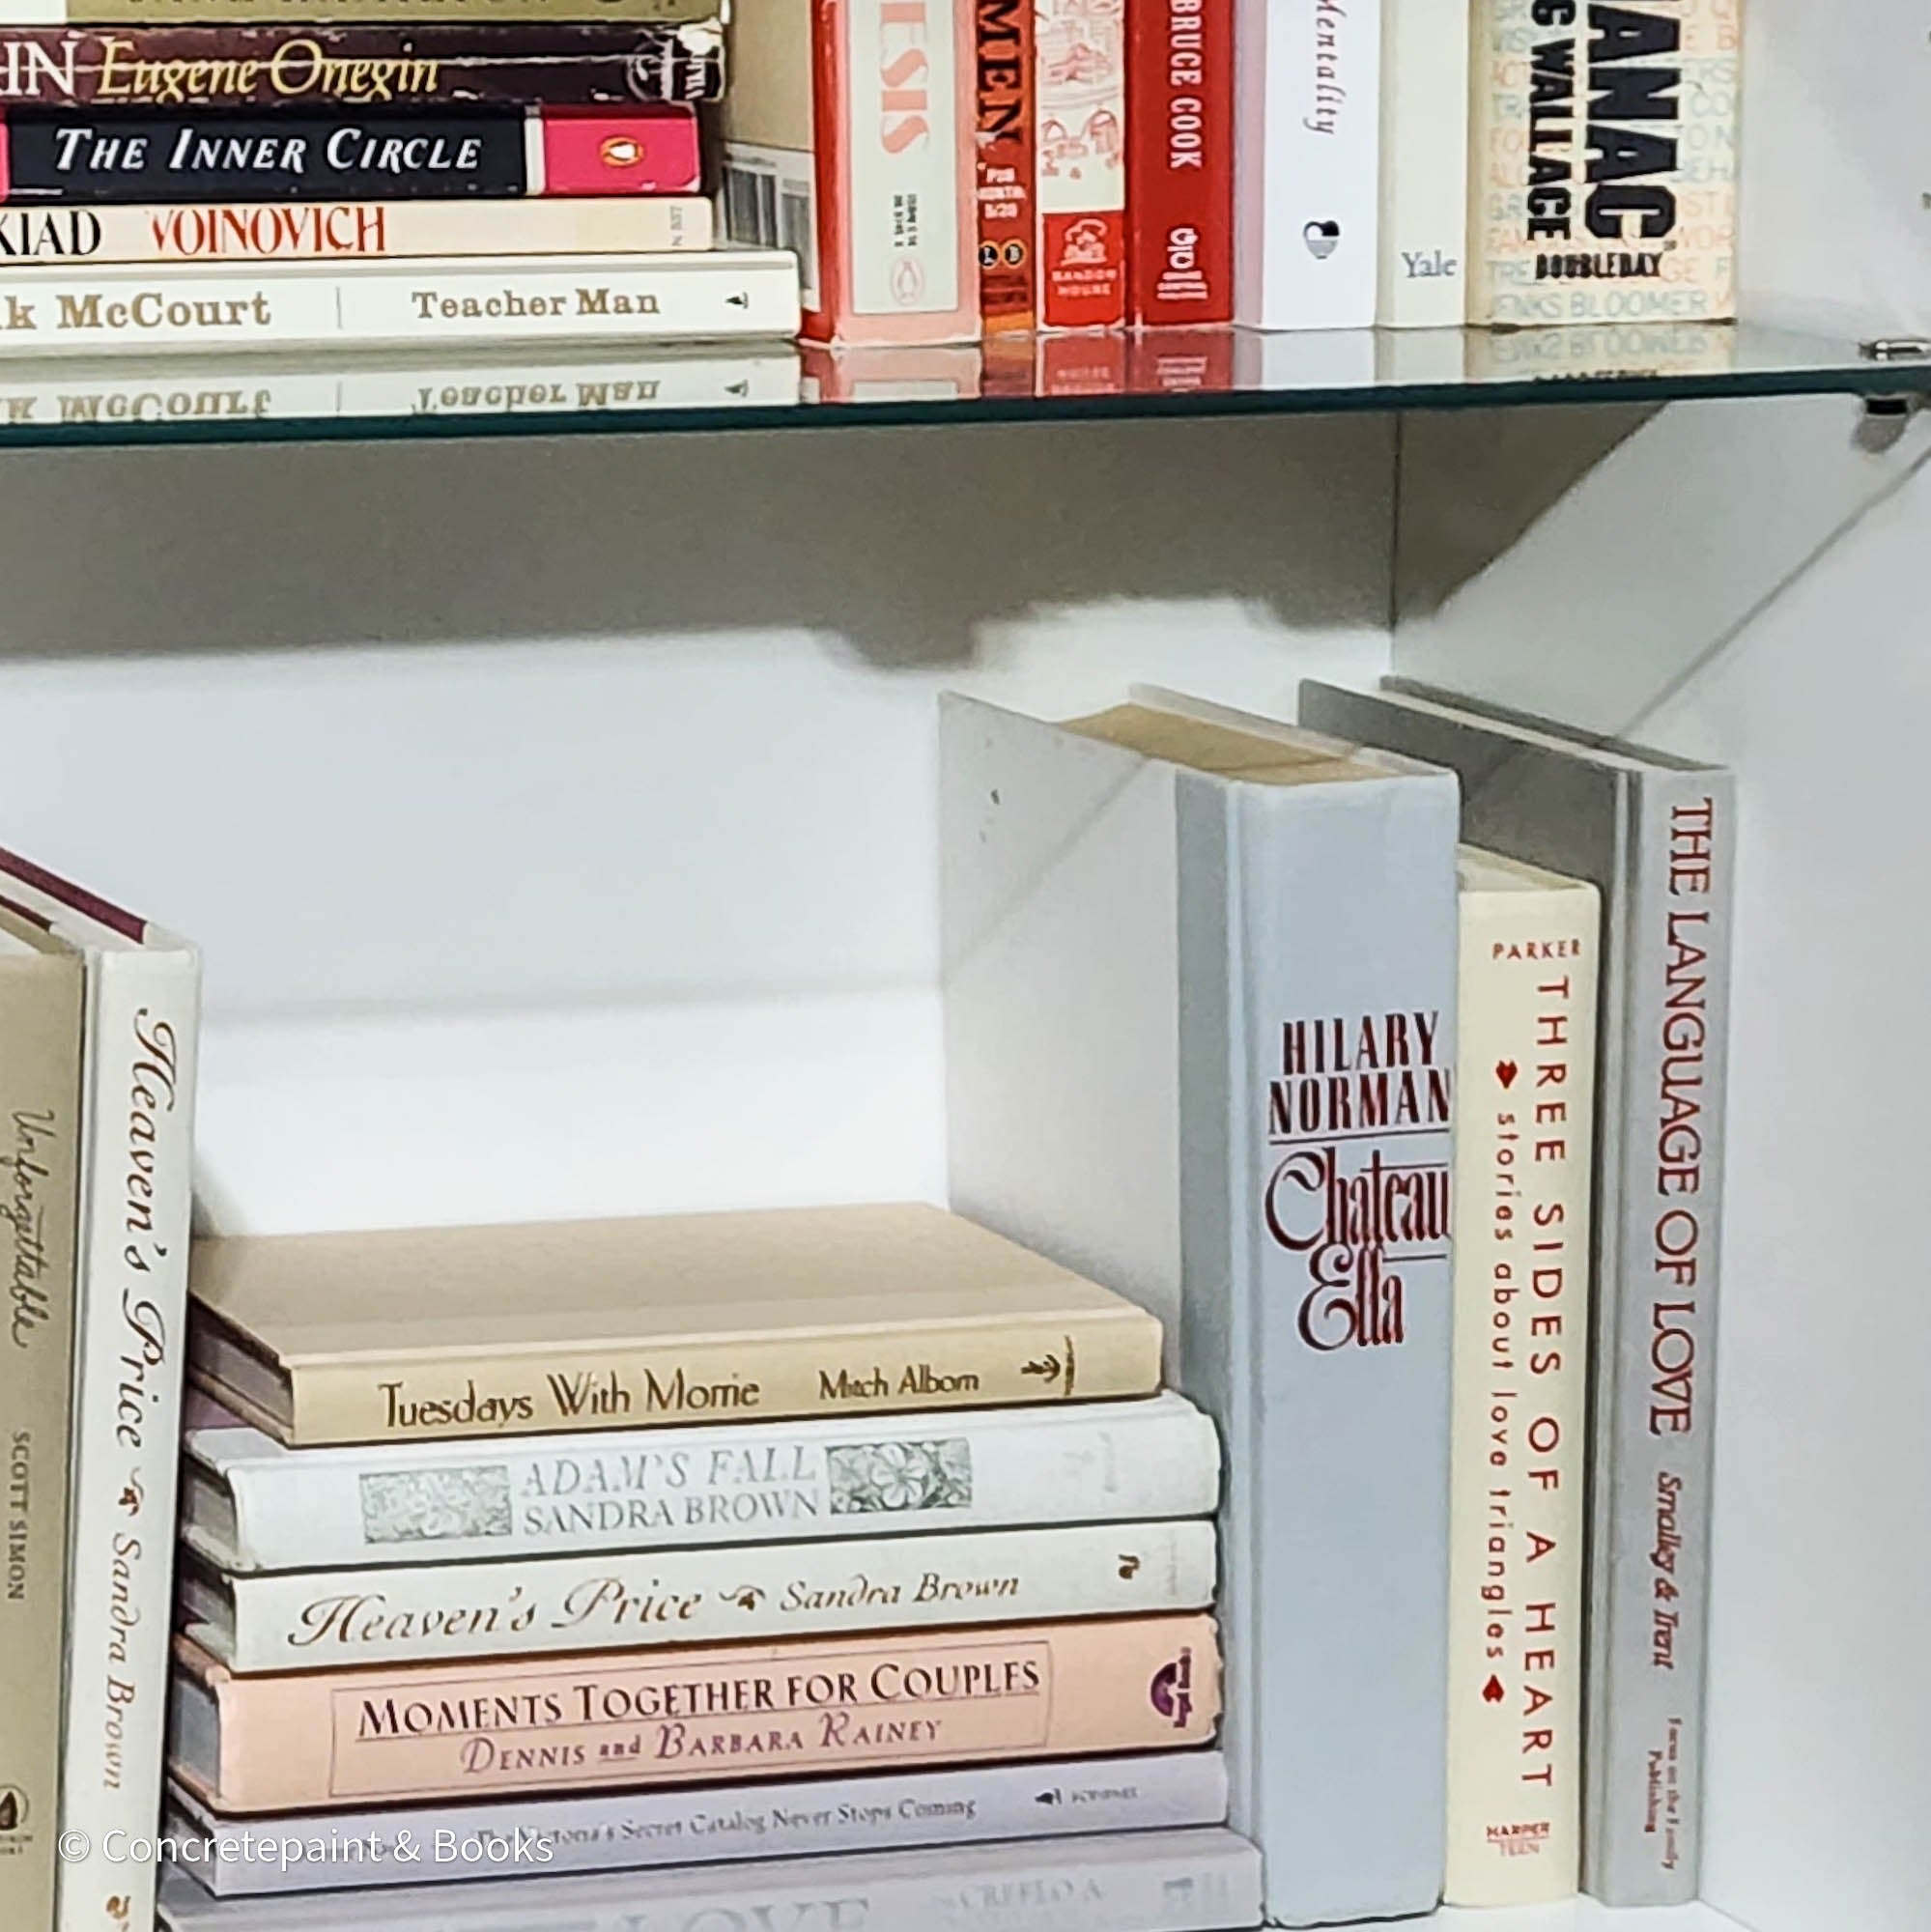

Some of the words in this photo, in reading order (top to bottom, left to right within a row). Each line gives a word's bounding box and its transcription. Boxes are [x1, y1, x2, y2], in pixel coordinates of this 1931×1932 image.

[0, 41, 75, 96] IN
[97, 36, 258, 103] Eugene
[271, 39, 439, 102] Onegin
[1170, 0, 1203, 86] BRUCE
[55, 128, 148, 171] THE
[168, 128, 307, 174] INNER
[327, 127, 482, 174] CIRCLE
[1170, 97, 1203, 169] COOK
[1527, 38, 1576, 242] WALLACE
[145, 206, 385, 256] VOINOVICH
[1401, 249, 1458, 278] Yale
[1536, 251, 1665, 280] DOUBLEDAY
[0, 296, 37, 329] k
[55, 291, 271, 329] McCourt
[412, 289, 568, 319] Teacher
[576, 288, 661, 316] Man
[1667, 796, 1714, 896] THE
[1492, 939, 1581, 960] PARKER
[1282, 1010, 1439, 1075] HILARY
[1533, 975, 1570, 1162] THREE
[1658, 909, 1711, 1197] LANGUAGE
[1267, 1067, 1452, 1135] NORMAN
[125, 1007, 178, 1273] Heaven's
[1493, 1112, 1520, 1240] stories
[1264, 1146, 1452, 1252] Chateau
[1654, 1208, 1701, 1288] OF
[1296, 1240, 1405, 1351] Ella
[1491, 1263, 1519, 1370] about
[1529, 1203, 1565, 1376] SIDES
[117, 1287, 168, 1450] Price
[378, 1379, 533, 1429] Tuesdays
[546, 1370, 631, 1417] With
[643, 1367, 760, 1412] Morrie
[818, 1366, 890, 1400] Mitch
[897, 1363, 980, 1396] Albom
[1648, 1299, 1697, 1436] LOVE
[1489, 1391, 1518, 1467] love
[1527, 1417, 1560, 1492] OF
[11, 1431, 32, 1514] SCOTT
[522, 1451, 690, 1498] ADAM'S
[706, 1444, 817, 1487] FALL
[523, 1498, 674, 1536] SANDRA
[684, 1490, 819, 1527] BROWN
[1525, 1530, 1557, 1563] A
[1648, 1470, 1683, 1574] Smalley
[7, 1520, 29, 1601] SIMON
[107, 1530, 142, 1662] Sandra
[1480, 1489, 1514, 1661] triangles
[1654, 1577, 1680, 1602] &
[287, 1585, 537, 1646] Heaven's
[550, 1576, 702, 1629] Price
[780, 1574, 901, 1612] Sandra
[913, 1572, 1021, 1604] Brown
[1652, 1605, 1679, 1671] Trent
[103, 1675, 135, 1790] Brown
[358, 1691, 562, 1738] MOMENTS
[573, 1678, 773, 1724] TOGETHER
[786, 1672, 859, 1707] FOR
[870, 1660, 1040, 1700] COUPLES
[1520, 1602, 1557, 1787] HEART
[459, 1737, 585, 1774] DENNIS
[598, 1740, 641, 1761] and
[655, 1723, 805, 1760] BARBARA
[819, 1711, 943, 1747] RAINEY
[691, 1809, 766, 1834] Catalog
[772, 1807, 832, 1829] Never
[838, 1803, 893, 1826] Stops
[897, 1798, 977, 1820] Coming
